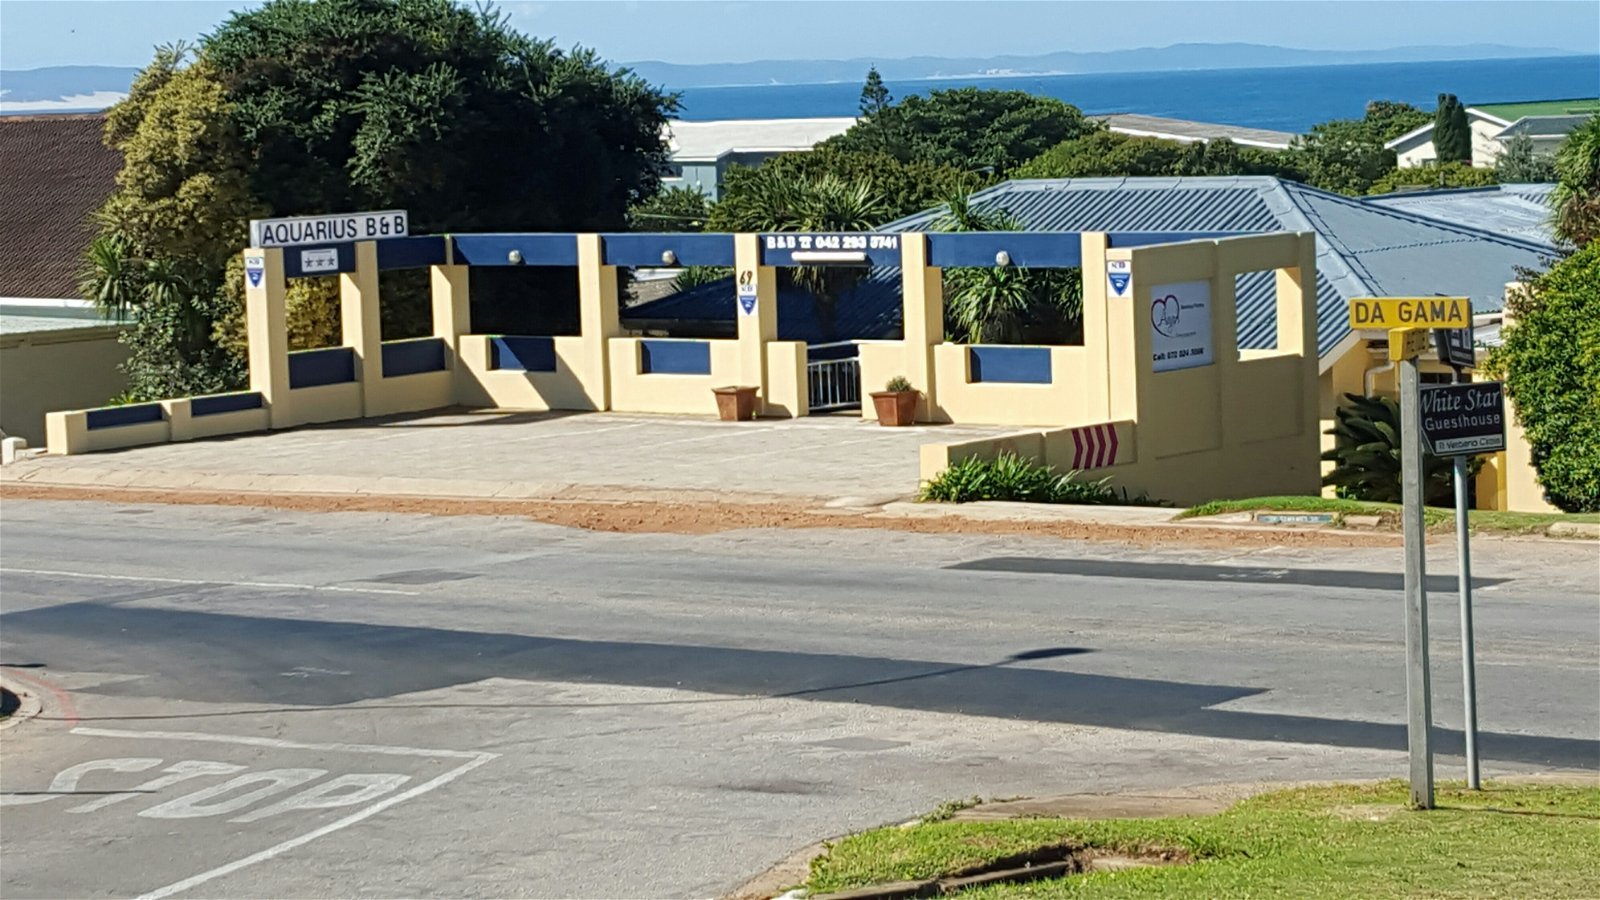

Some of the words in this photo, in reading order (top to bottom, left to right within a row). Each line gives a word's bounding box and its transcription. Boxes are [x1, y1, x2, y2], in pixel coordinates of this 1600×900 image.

[262, 218, 357, 245] AQUARIUS
[815, 235, 840, 249] 042
[739, 270, 753, 285] 69
[1355, 302, 1385, 324] DA
[1398, 300, 1462, 323] GAMA
[1420, 388, 1461, 414] White
[1464, 388, 1501, 412] Star
[1424, 413, 1501, 432] Guesthouse
[0, 757, 412, 823] STOP
